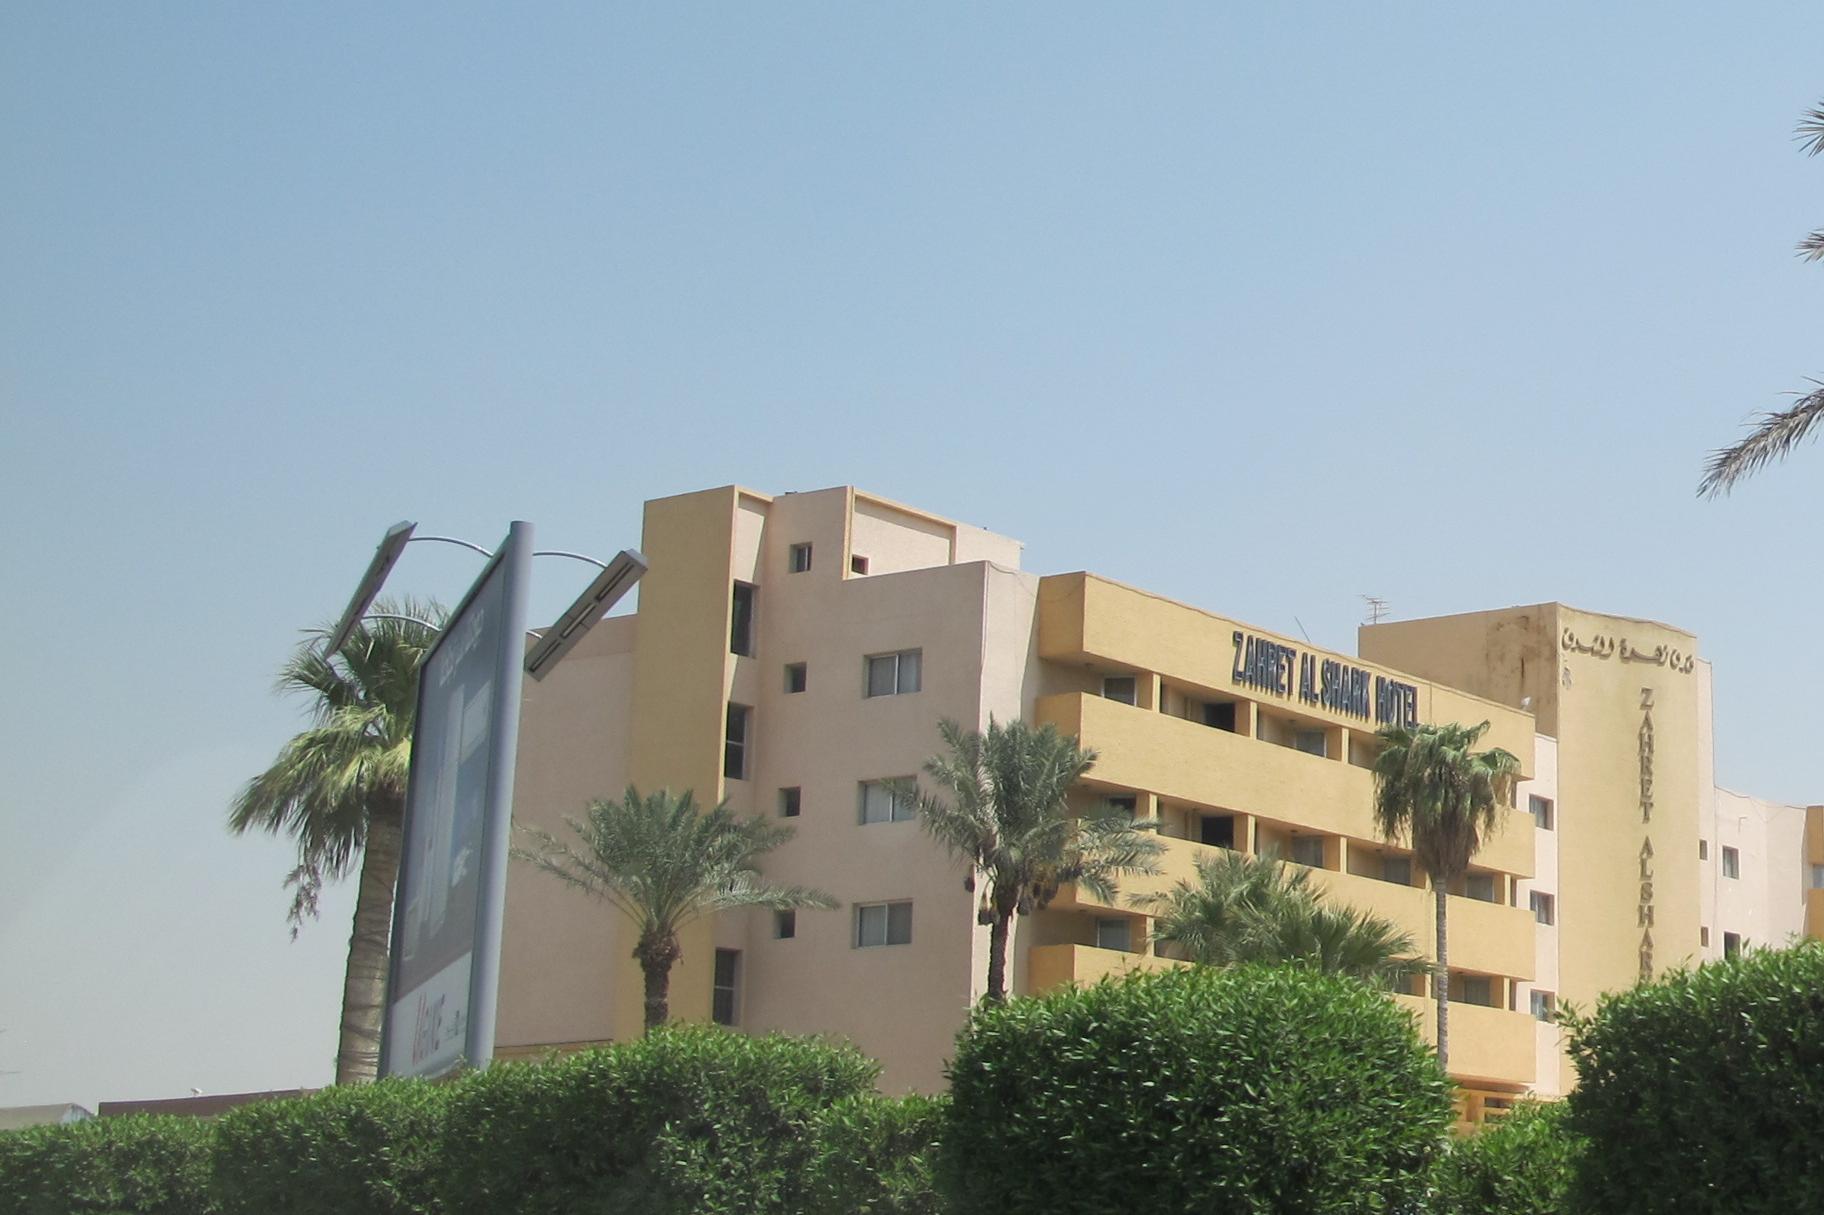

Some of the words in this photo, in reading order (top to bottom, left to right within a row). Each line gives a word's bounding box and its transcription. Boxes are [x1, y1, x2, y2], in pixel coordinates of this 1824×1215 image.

[1232, 630, 1297, 700] ZAHRET
[1299, 651, 1319, 704] AL
[1320, 658, 1371, 722] SHARK
[1375, 675, 1420, 728] HOTEL
[1637, 687, 1655, 824] ZAHRET
